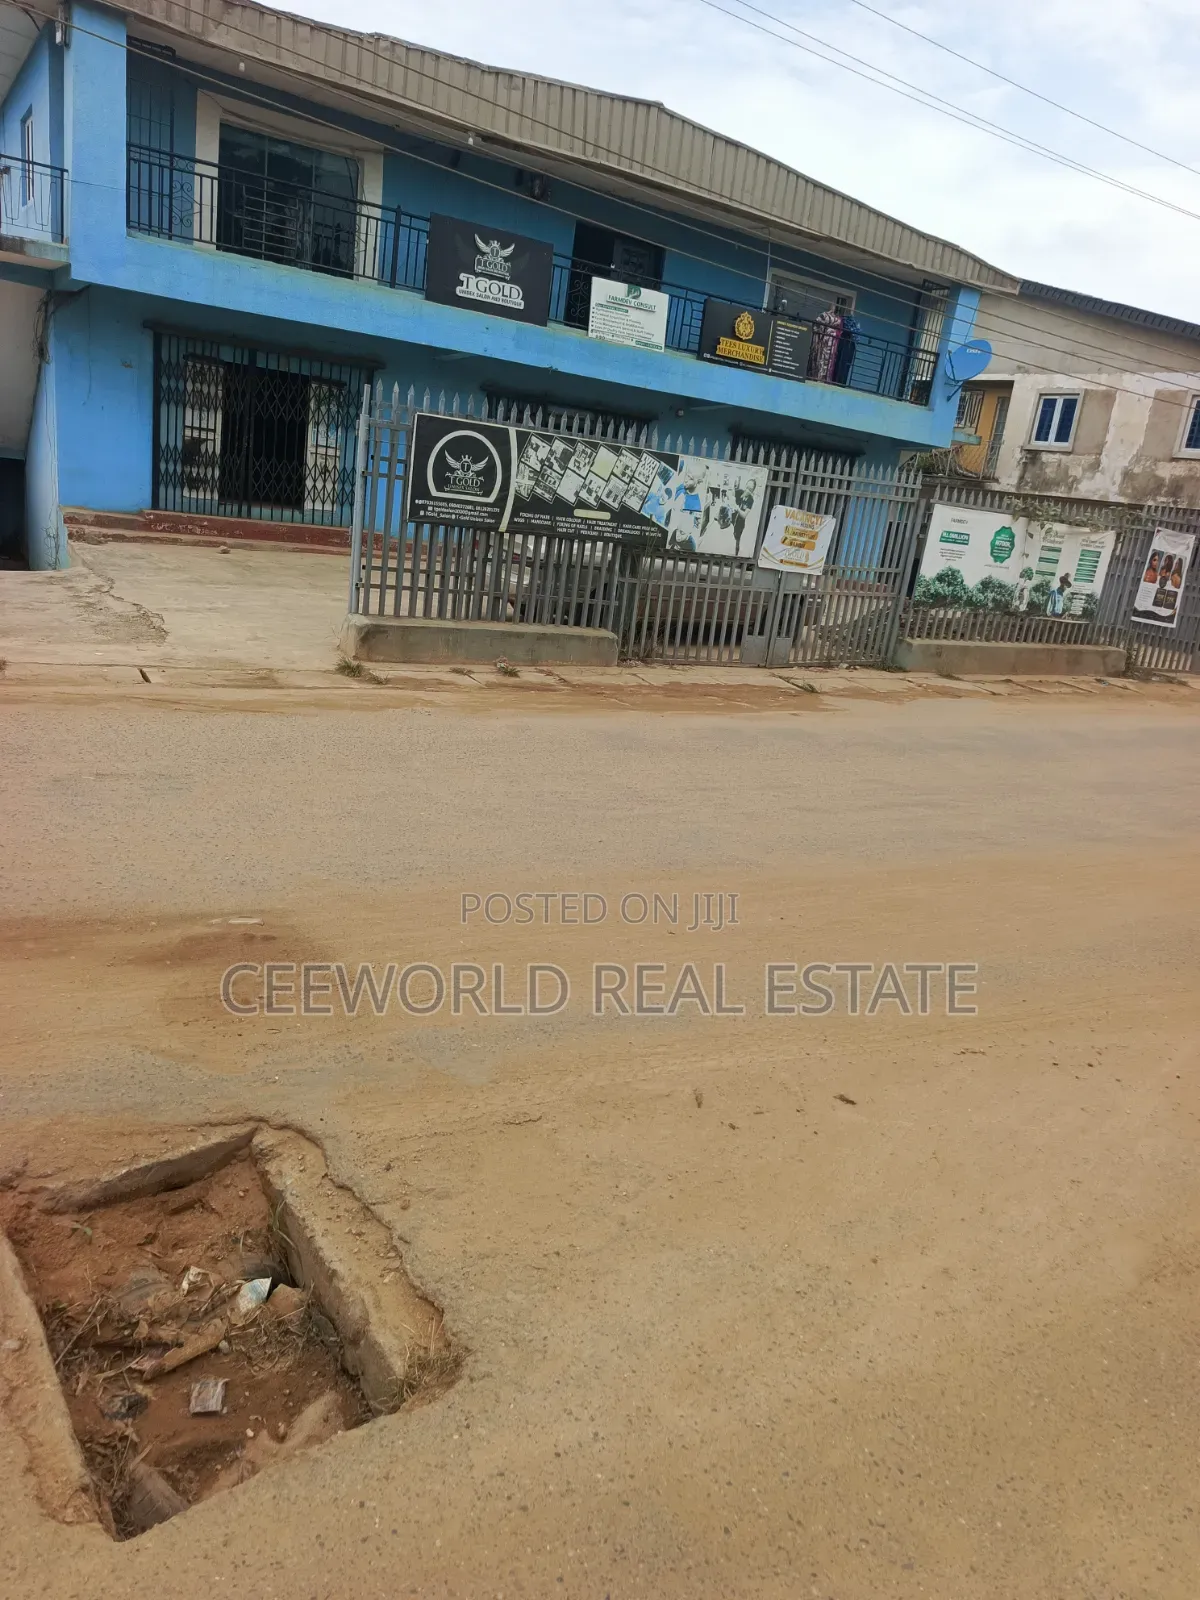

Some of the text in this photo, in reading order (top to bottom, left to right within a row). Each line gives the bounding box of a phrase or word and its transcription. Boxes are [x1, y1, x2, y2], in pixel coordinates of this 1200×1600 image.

[462, 274, 521, 300] T GOLD
[608, 294, 632, 305] FARMDEV
[633, 300, 656, 311] CONSULT
[718, 347, 764, 363] MERCHANDISE
[720, 339, 737, 349] TEES
[737, 342, 764, 355] LUXURY
[456, 477, 480, 488] GOLD
